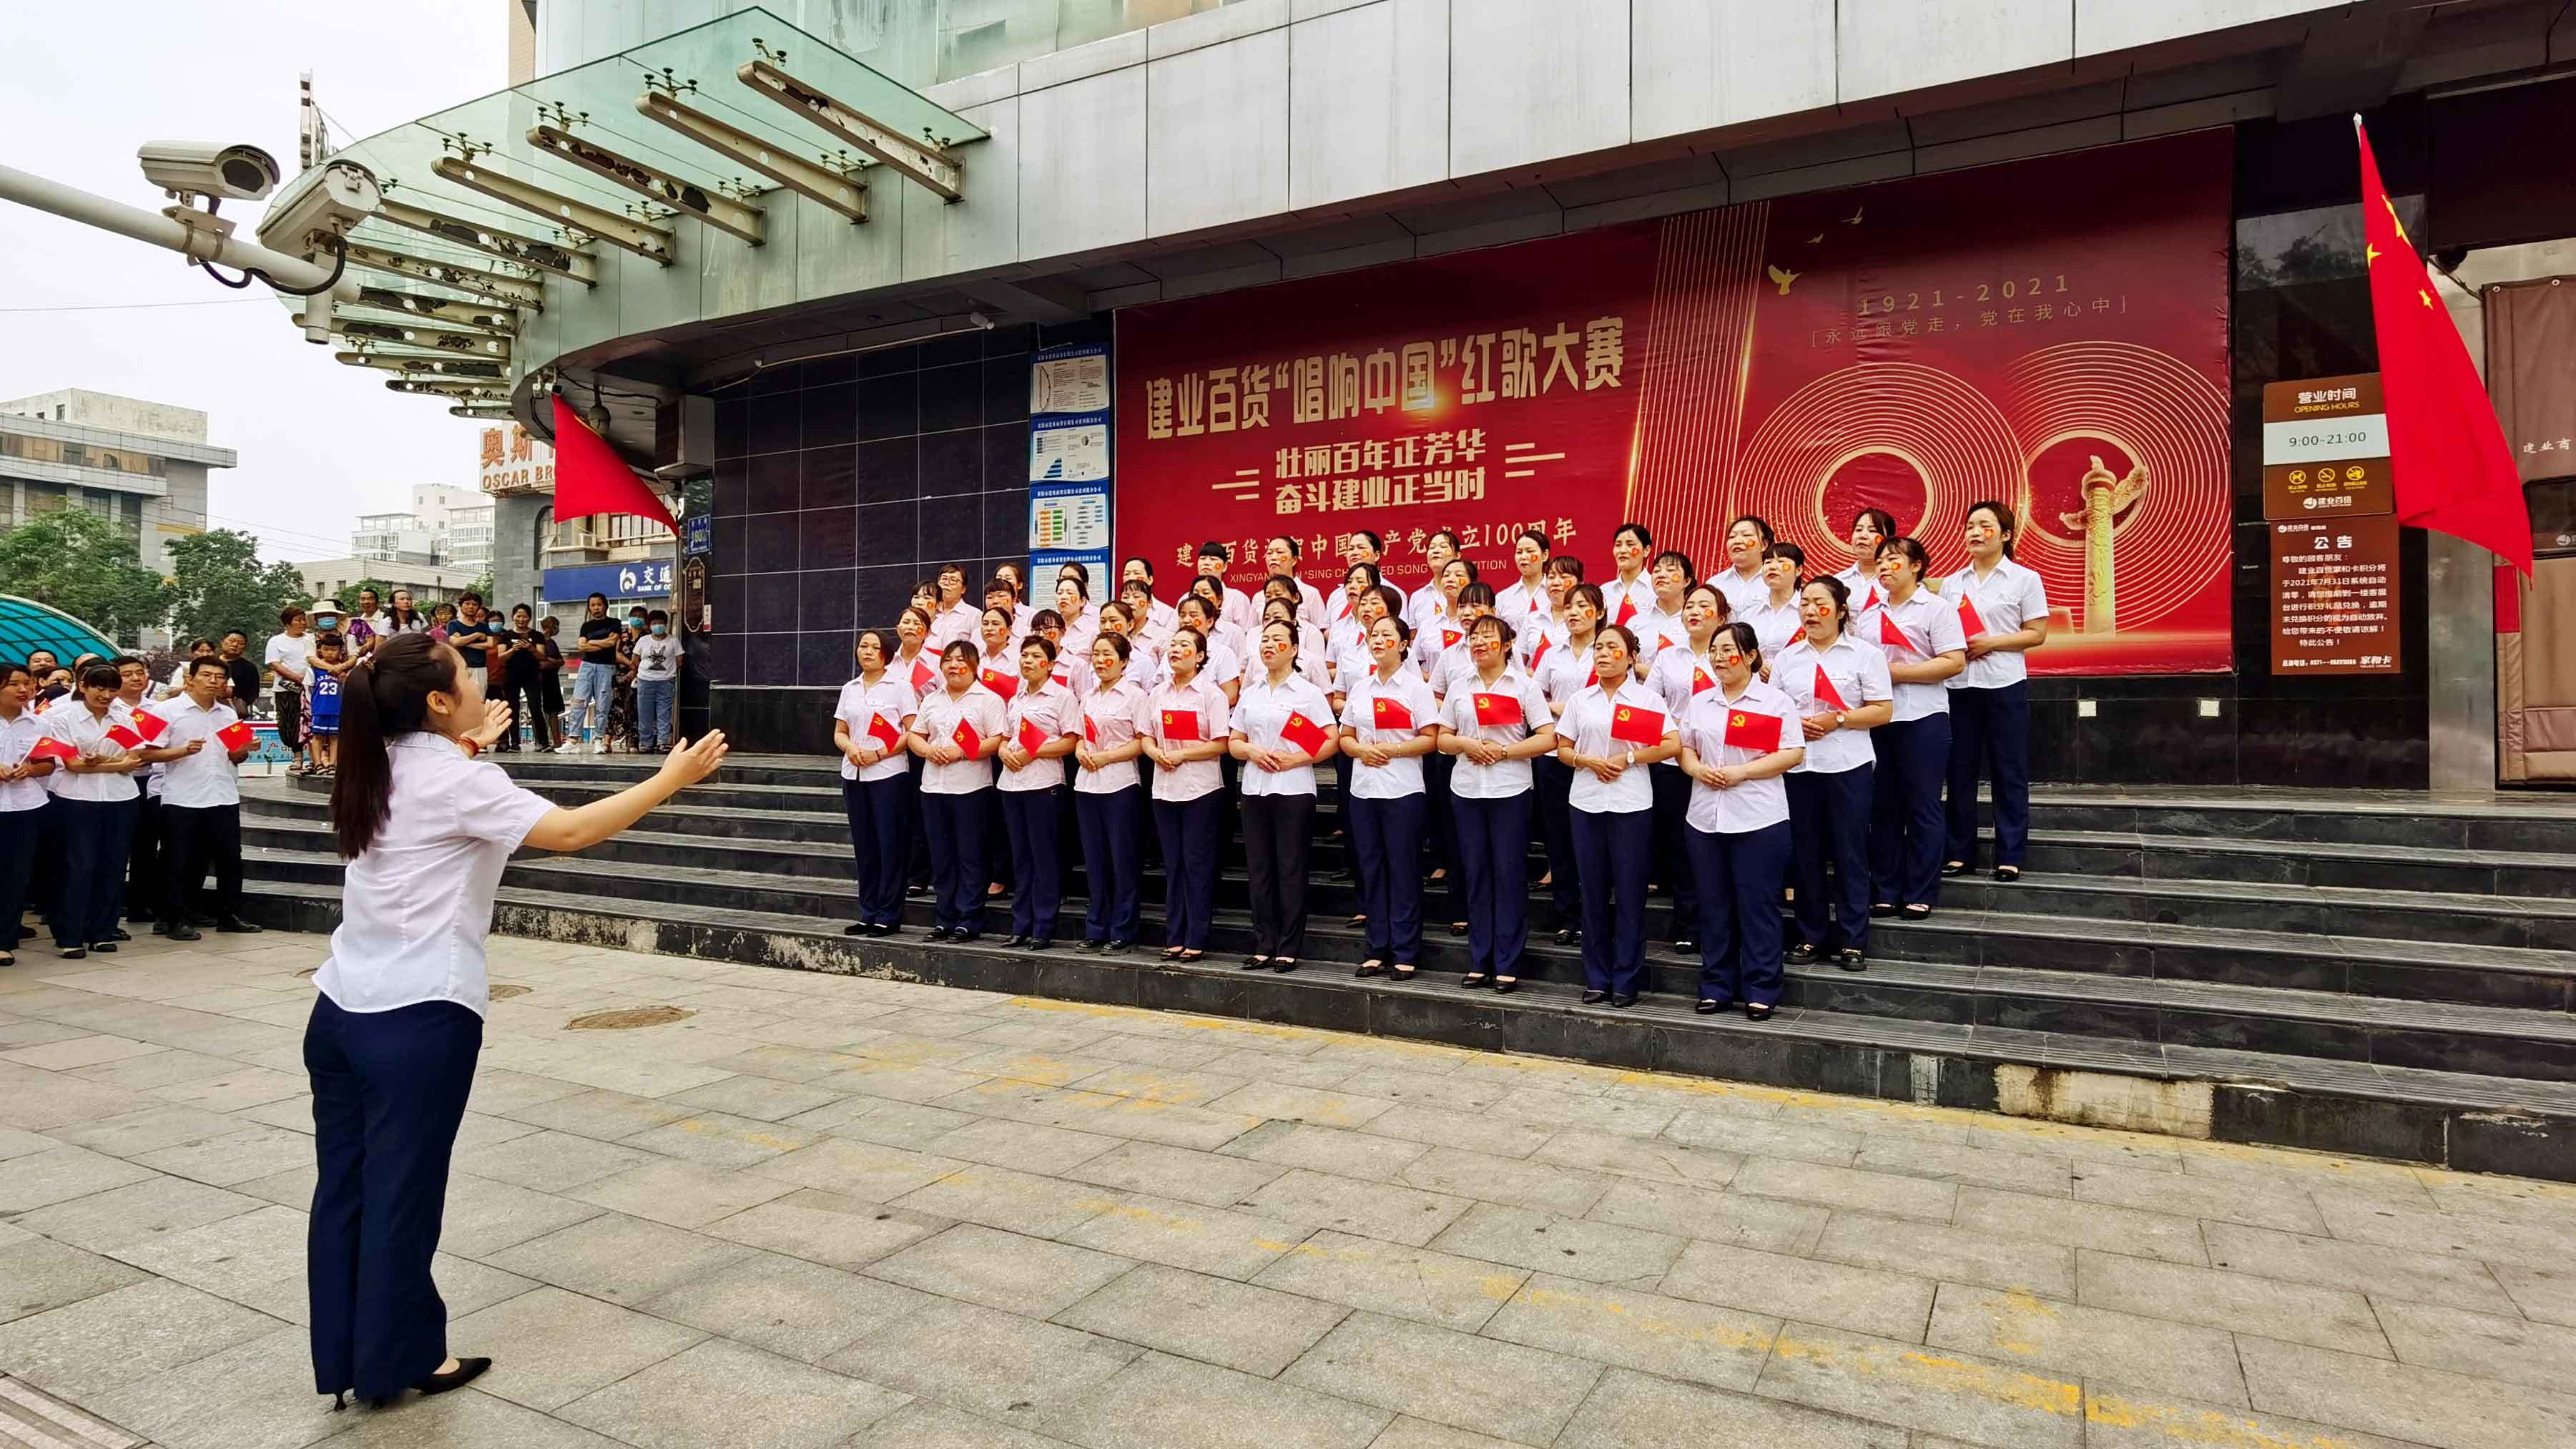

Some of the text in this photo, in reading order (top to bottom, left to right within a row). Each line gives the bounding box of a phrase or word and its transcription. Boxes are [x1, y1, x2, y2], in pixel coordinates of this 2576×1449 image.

[1859, 275, 2069, 315] 1921-2021
[2298, 388, 2356, 404] 营业时间
[2294, 401, 2360, 413] OPENING HOURS
[481, 424, 554, 469] 奥斯
[2289, 432, 2366, 447] 9:00-21:00
[2523, 438, 2572, 454] 建业商
[1276, 429, 1487, 479] 壮丽百年正芳华
[483, 469, 529, 489] OSCAR
[1276, 466, 1485, 514] 奋斗建业正当时
[1230, 573, 1271, 583] XINGYAN
[1397, 564, 1428, 575] SONG
[319, 682, 338, 695] 23
